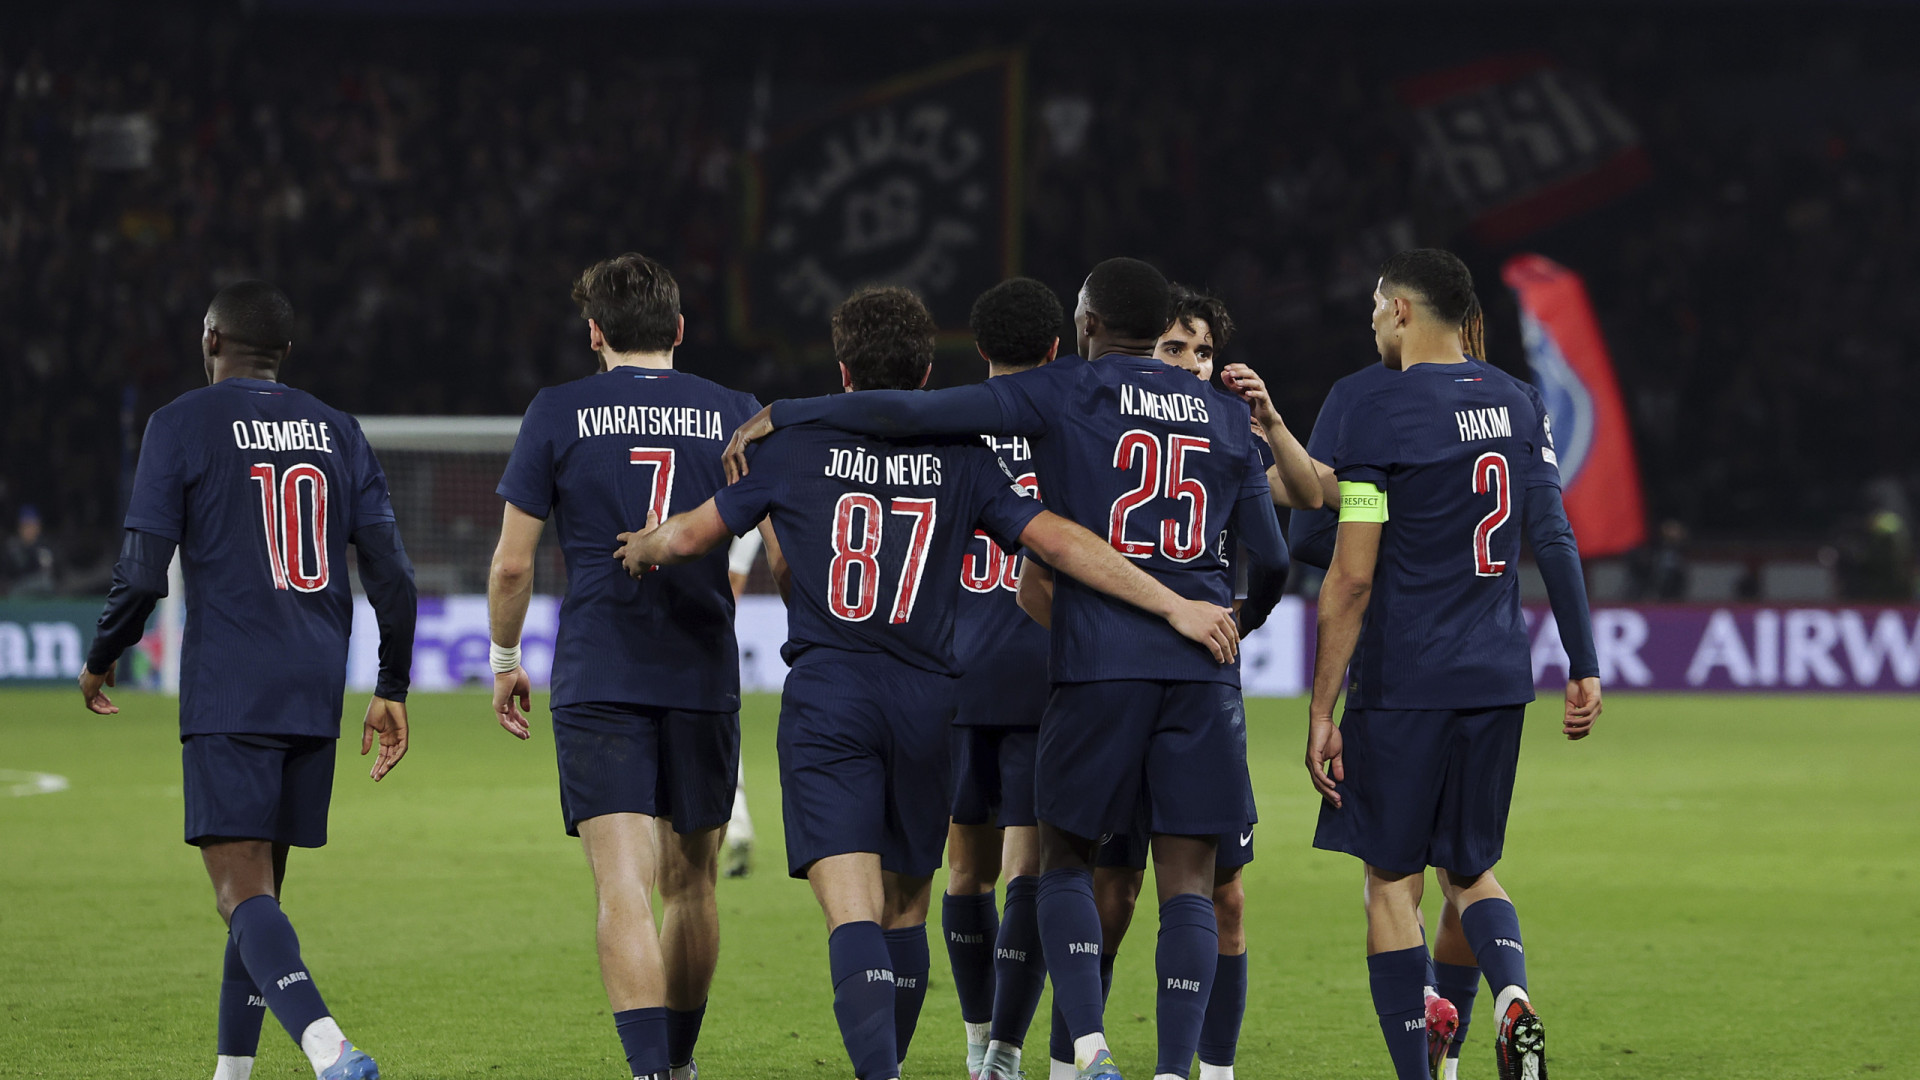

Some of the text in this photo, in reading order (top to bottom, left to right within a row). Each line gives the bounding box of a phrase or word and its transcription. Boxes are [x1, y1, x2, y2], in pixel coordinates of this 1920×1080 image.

[1120, 384, 1210, 423] N.MENDES
[233, 418, 333, 454] O.DEMBÉLÉ
[576, 406, 724, 442] KVARATSKHELIA
[1455, 406, 1512, 442] HAKIMI
[824, 446, 942, 487] JOÃO NEVES
[629, 446, 676, 571] 7
[1108, 428, 1211, 563] 25
[1344, 497, 1379, 506] RESPECT
[250, 462, 330, 593] 10
[1472, 451, 1511, 577] 2
[827, 491, 938, 625] 87
[1685, 608, 1920, 687] AIRW
[948, 931, 984, 944] PARIS
[997, 948, 1027, 962] PARIS
[1068, 942, 1099, 955] PARIS
[277, 971, 308, 991] PARIS
[893, 977, 917, 988] RIS
[1166, 977, 1201, 993] PARIS
